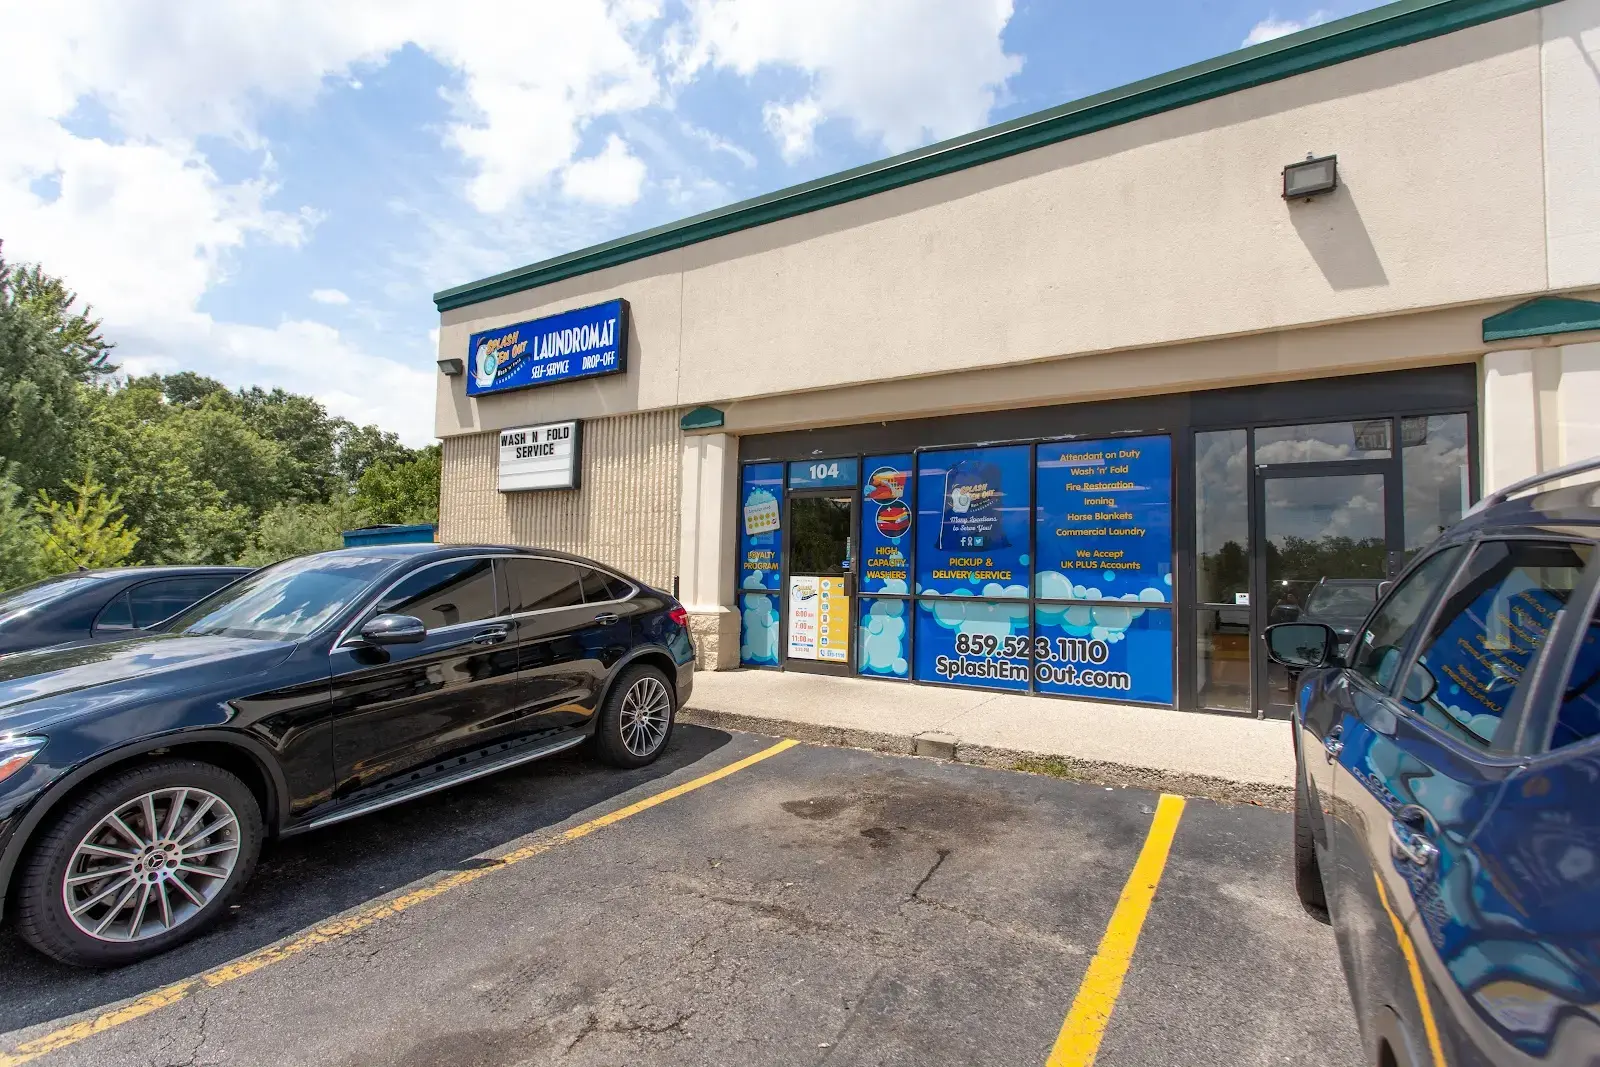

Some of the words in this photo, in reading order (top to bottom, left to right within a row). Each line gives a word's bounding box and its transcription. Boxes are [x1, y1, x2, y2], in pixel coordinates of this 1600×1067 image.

[533, 318, 616, 361] LAUNDROMAT
[531, 359, 570, 379] SELF-SERVICE
[581, 351, 616, 370] DROP-OFF
[501, 432, 526, 447] WASH
[532, 431, 538, 443] N
[546, 426, 569, 441] FOLD
[516, 443, 554, 459] SERVICE
[1060, 451, 1103, 461] Attendant
[1119, 450, 1141, 459] Duty
[809, 463, 840, 480] 104
[1070, 467, 1094, 476] Wash
[1110, 465, 1129, 474] Fold
[1065, 483, 1081, 491] Fire
[1083, 481, 1134, 490] Restoration
[1084, 497, 1115, 506] Ironing
[1067, 513, 1092, 521] Horse
[1094, 511, 1133, 520] Blankets
[1056, 527, 1107, 537] Commercial
[1109, 527, 1146, 537] Laundry
[747, 551, 776, 559] LOYALTY
[875, 547, 898, 555] HIGH
[1076, 550, 1091, 558] We
[1093, 549, 1124, 559] Accept
[743, 562, 779, 570] PROGRAM
[867, 558, 906, 567] CAPACITY
[949, 558, 983, 567] PICKUP
[985, 558, 993, 567] &
[1060, 561, 1074, 569] UK
[1075, 561, 1098, 569] PLUS
[1100, 561, 1141, 569] Accounts
[866, 570, 907, 580] WASHERS
[932, 570, 972, 579] DELIVERY
[974, 570, 1012, 580] SERVICE
[955, 633, 1108, 664] 859.523.1110
